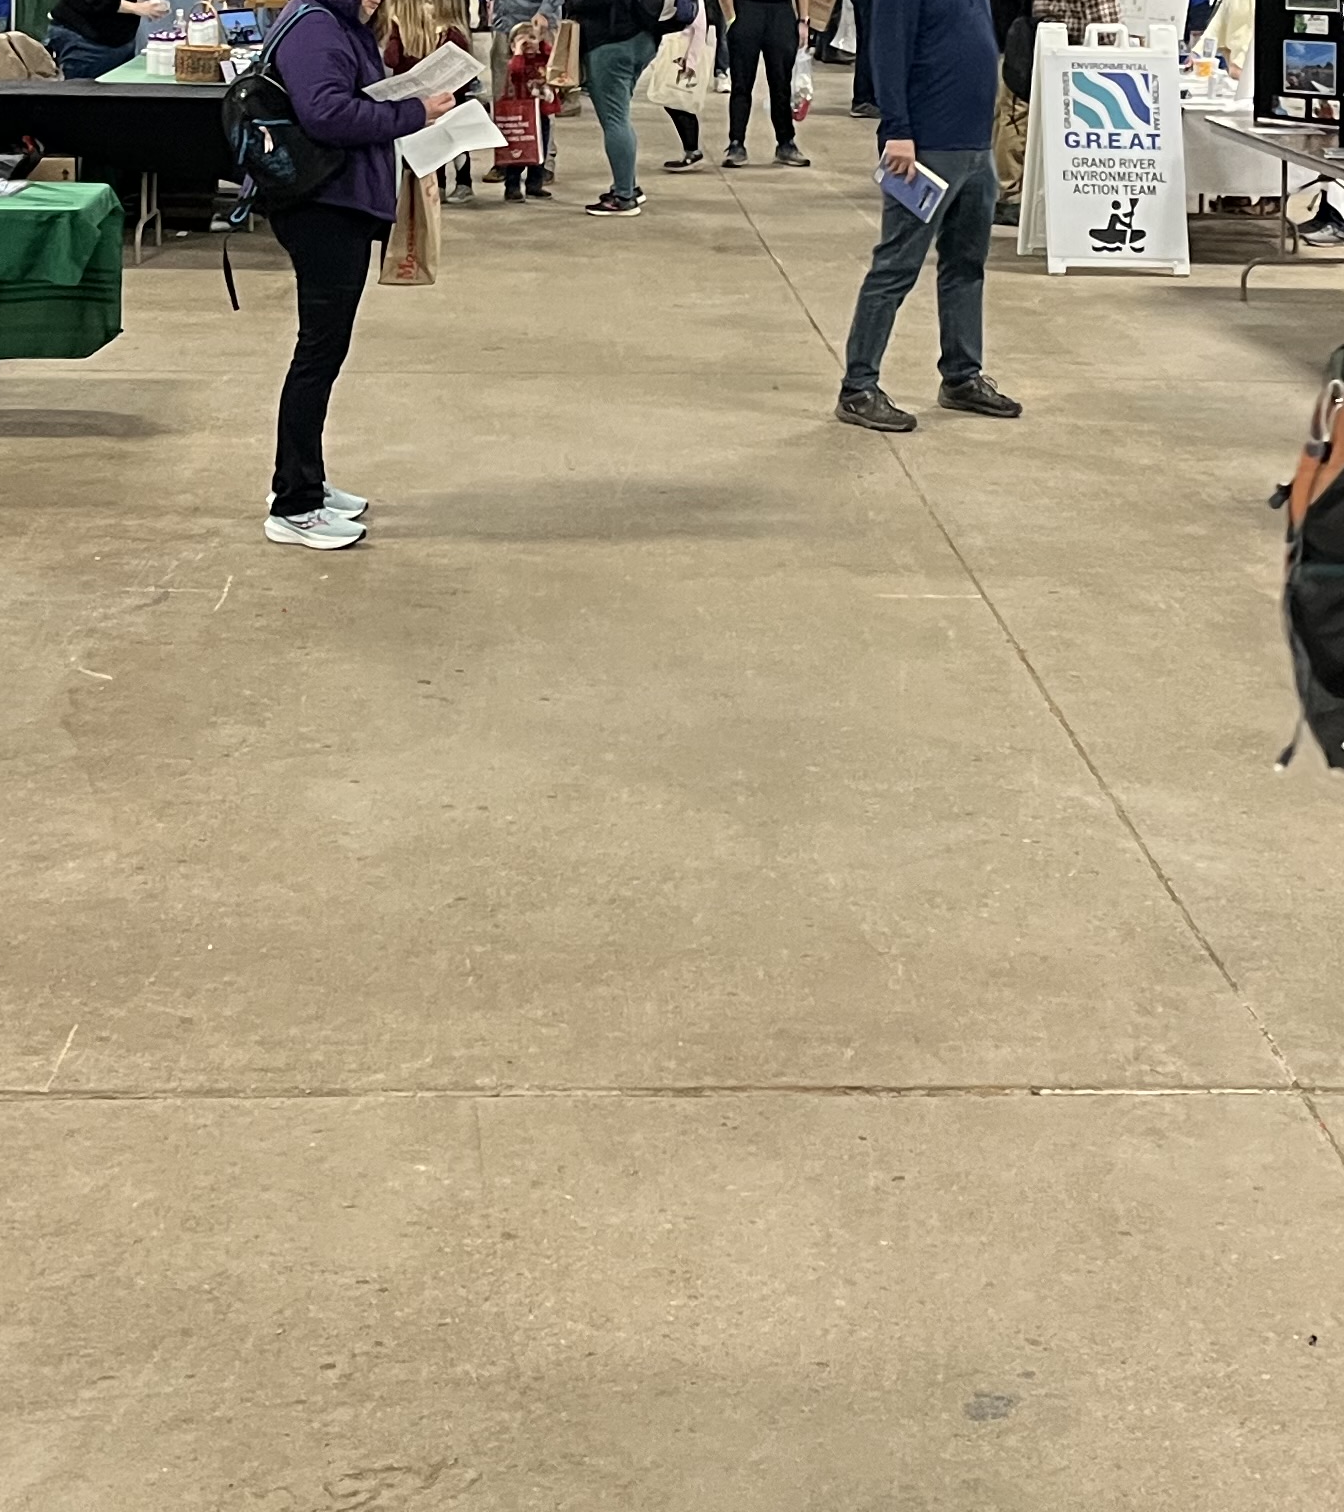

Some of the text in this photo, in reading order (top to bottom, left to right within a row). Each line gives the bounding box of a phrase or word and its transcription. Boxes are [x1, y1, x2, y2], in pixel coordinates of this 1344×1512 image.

[1071, 62, 1149, 71] ENVIRONMENTAL
[1071, 157, 1156, 169] GRAND RIVER
[1062, 170, 1167, 183] ENVIRONMENTAL
[1073, 184, 1157, 195] ACTION TEAM
